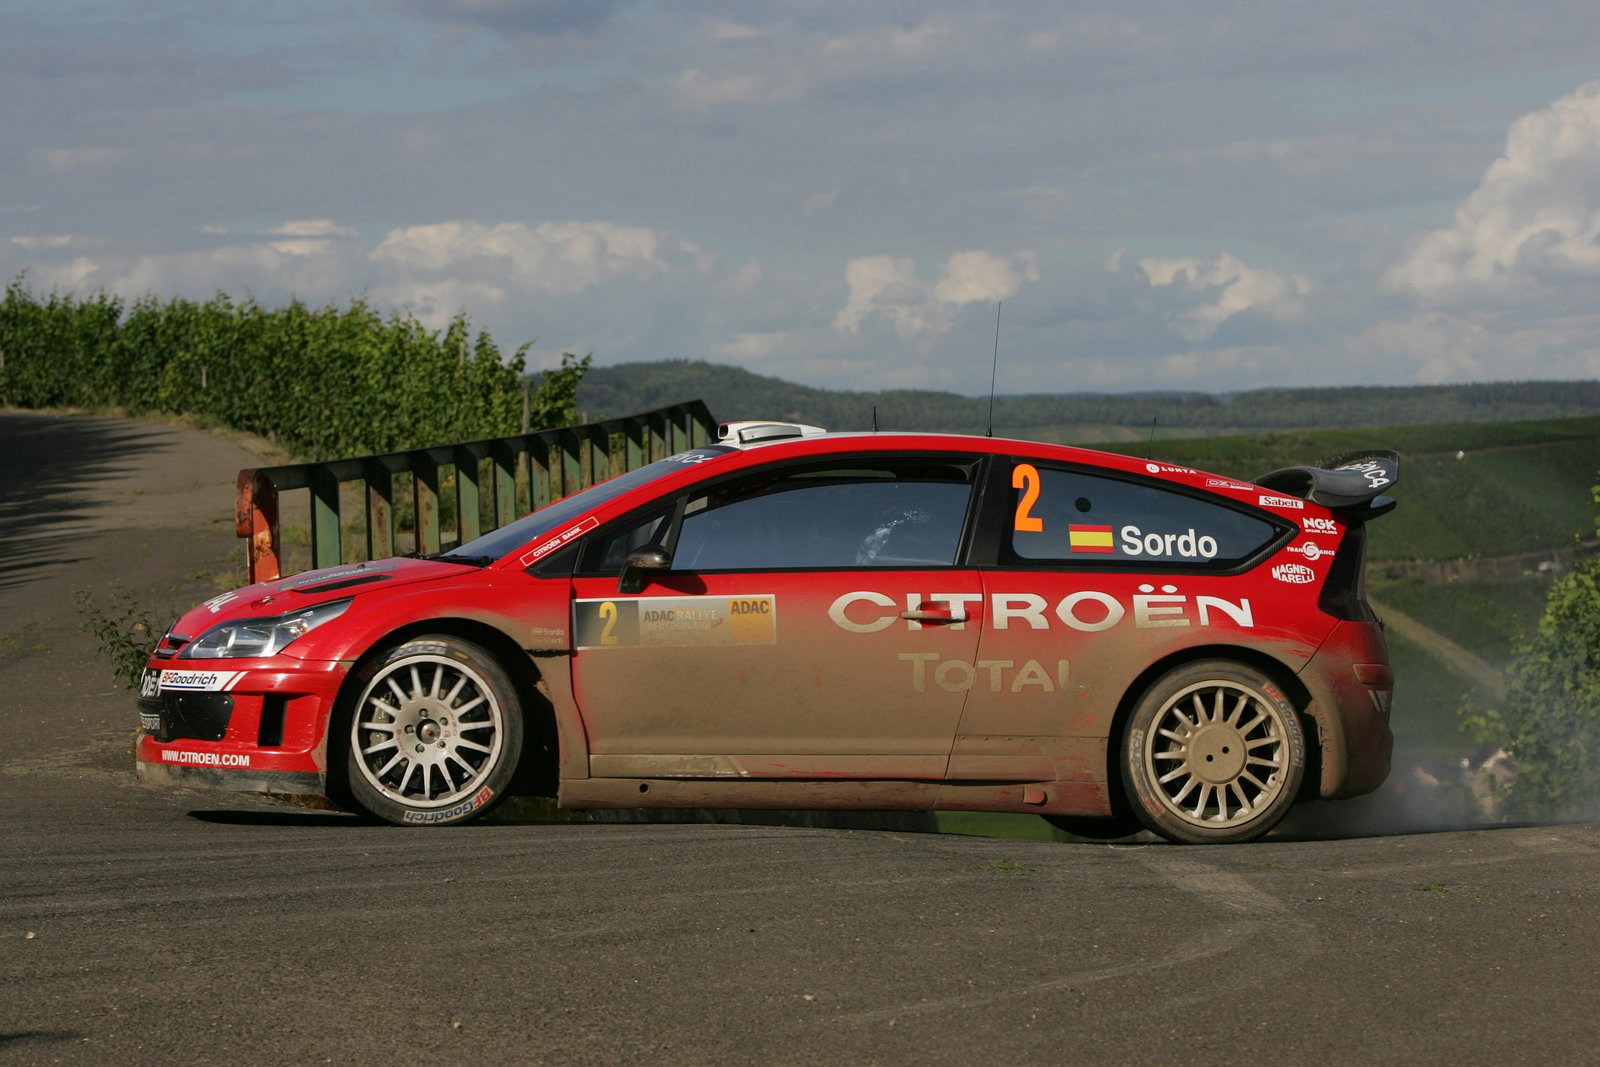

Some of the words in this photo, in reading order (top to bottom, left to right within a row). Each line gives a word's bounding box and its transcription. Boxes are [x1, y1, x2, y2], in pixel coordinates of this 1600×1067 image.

[1012, 464, 1043, 532] 2
[1264, 496, 1300, 508] Sabelt
[1302, 517, 1337, 530] NGK
[561, 526, 582, 540] BANK
[1120, 525, 1218, 558] Sordo
[731, 601, 769, 614] ADAC
[828, 583, 1255, 634] CITROËN
[598, 601, 620, 645] 2
[643, 610, 675, 622] ADAC
[162, 672, 217, 685] BFGoodrich
[161, 749, 250, 767] WWW.CITROEN.COM
[404, 786, 493, 823] BFGoodrich
